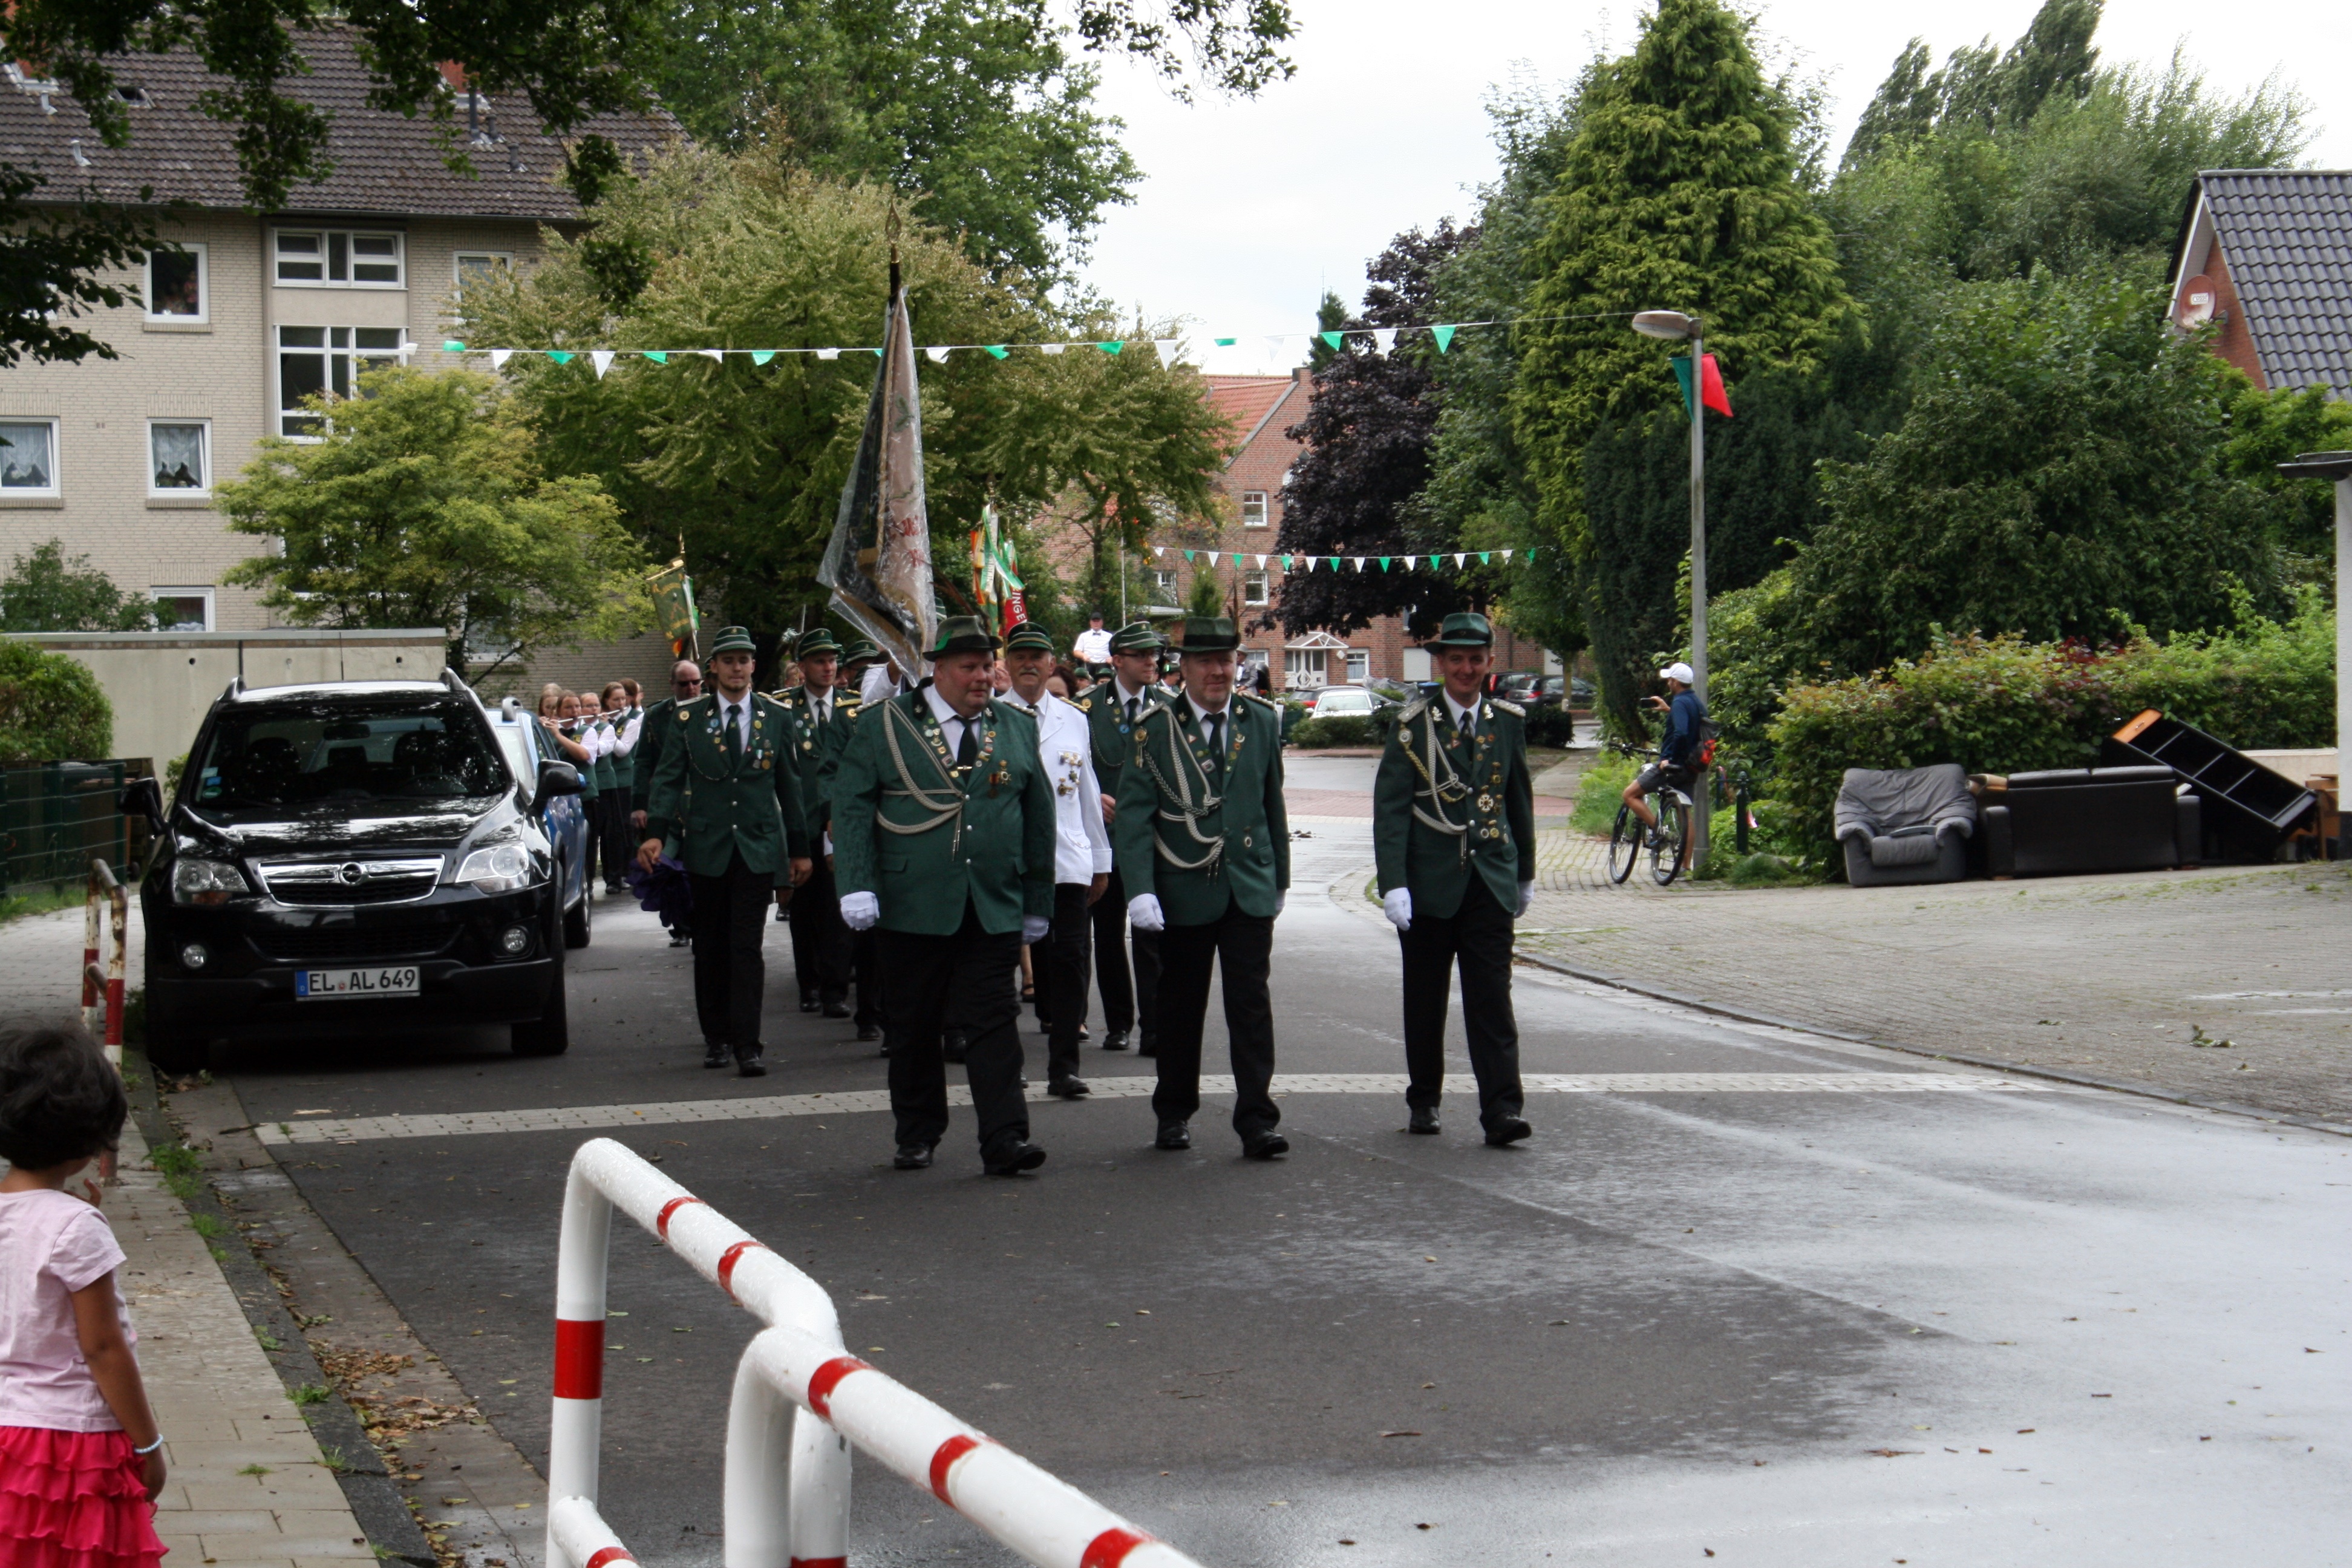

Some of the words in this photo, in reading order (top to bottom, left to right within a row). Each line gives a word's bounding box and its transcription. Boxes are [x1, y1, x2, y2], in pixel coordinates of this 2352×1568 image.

[1011, 589, 1027, 623] INGE
[310, 973, 335, 991] EL
[350, 972, 374, 990] AL
[380, 969, 416, 988] 649
